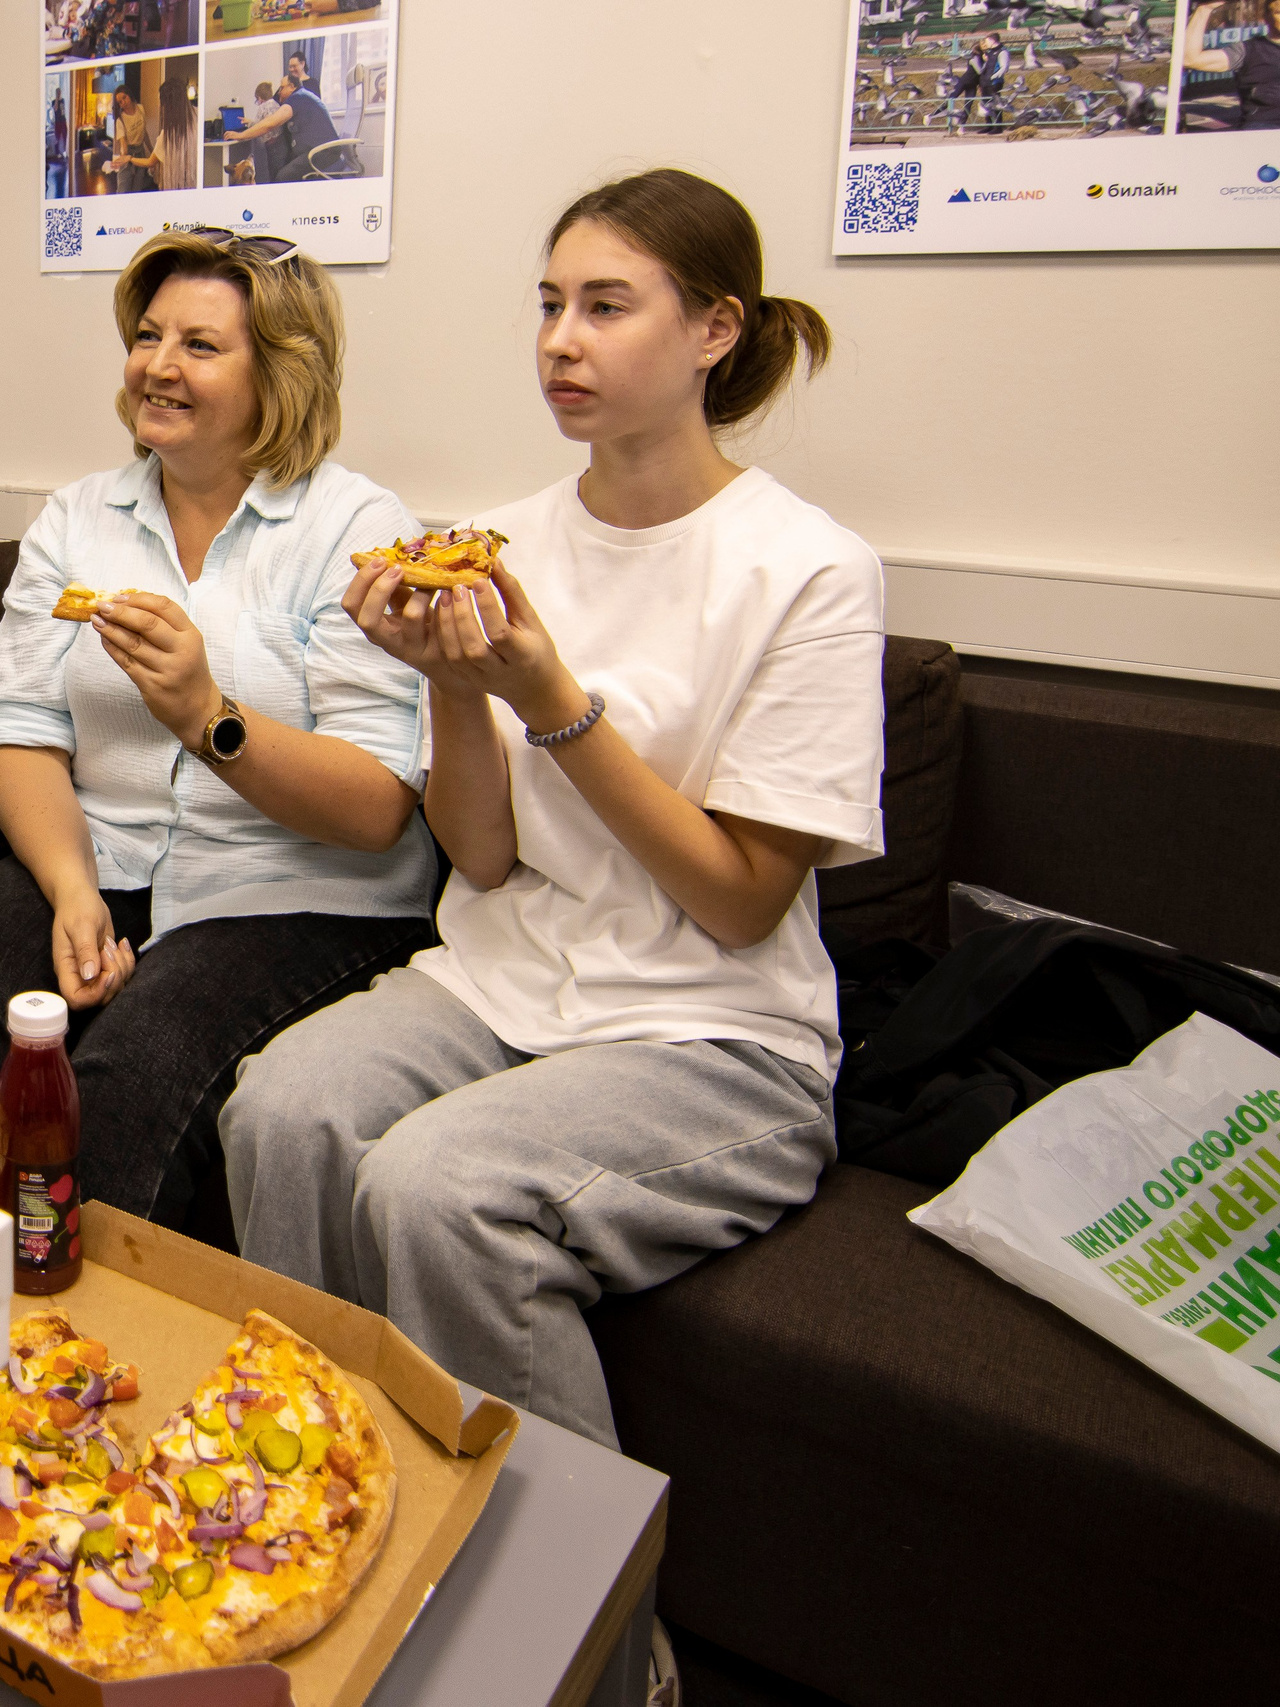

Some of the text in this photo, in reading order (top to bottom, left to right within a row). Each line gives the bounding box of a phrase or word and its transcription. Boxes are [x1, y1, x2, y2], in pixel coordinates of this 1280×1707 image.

[973, 189, 1046, 202] EVERLAND
[1108, 183, 1177, 198] билайн
[108, 227, 144, 236] EVERLAND
